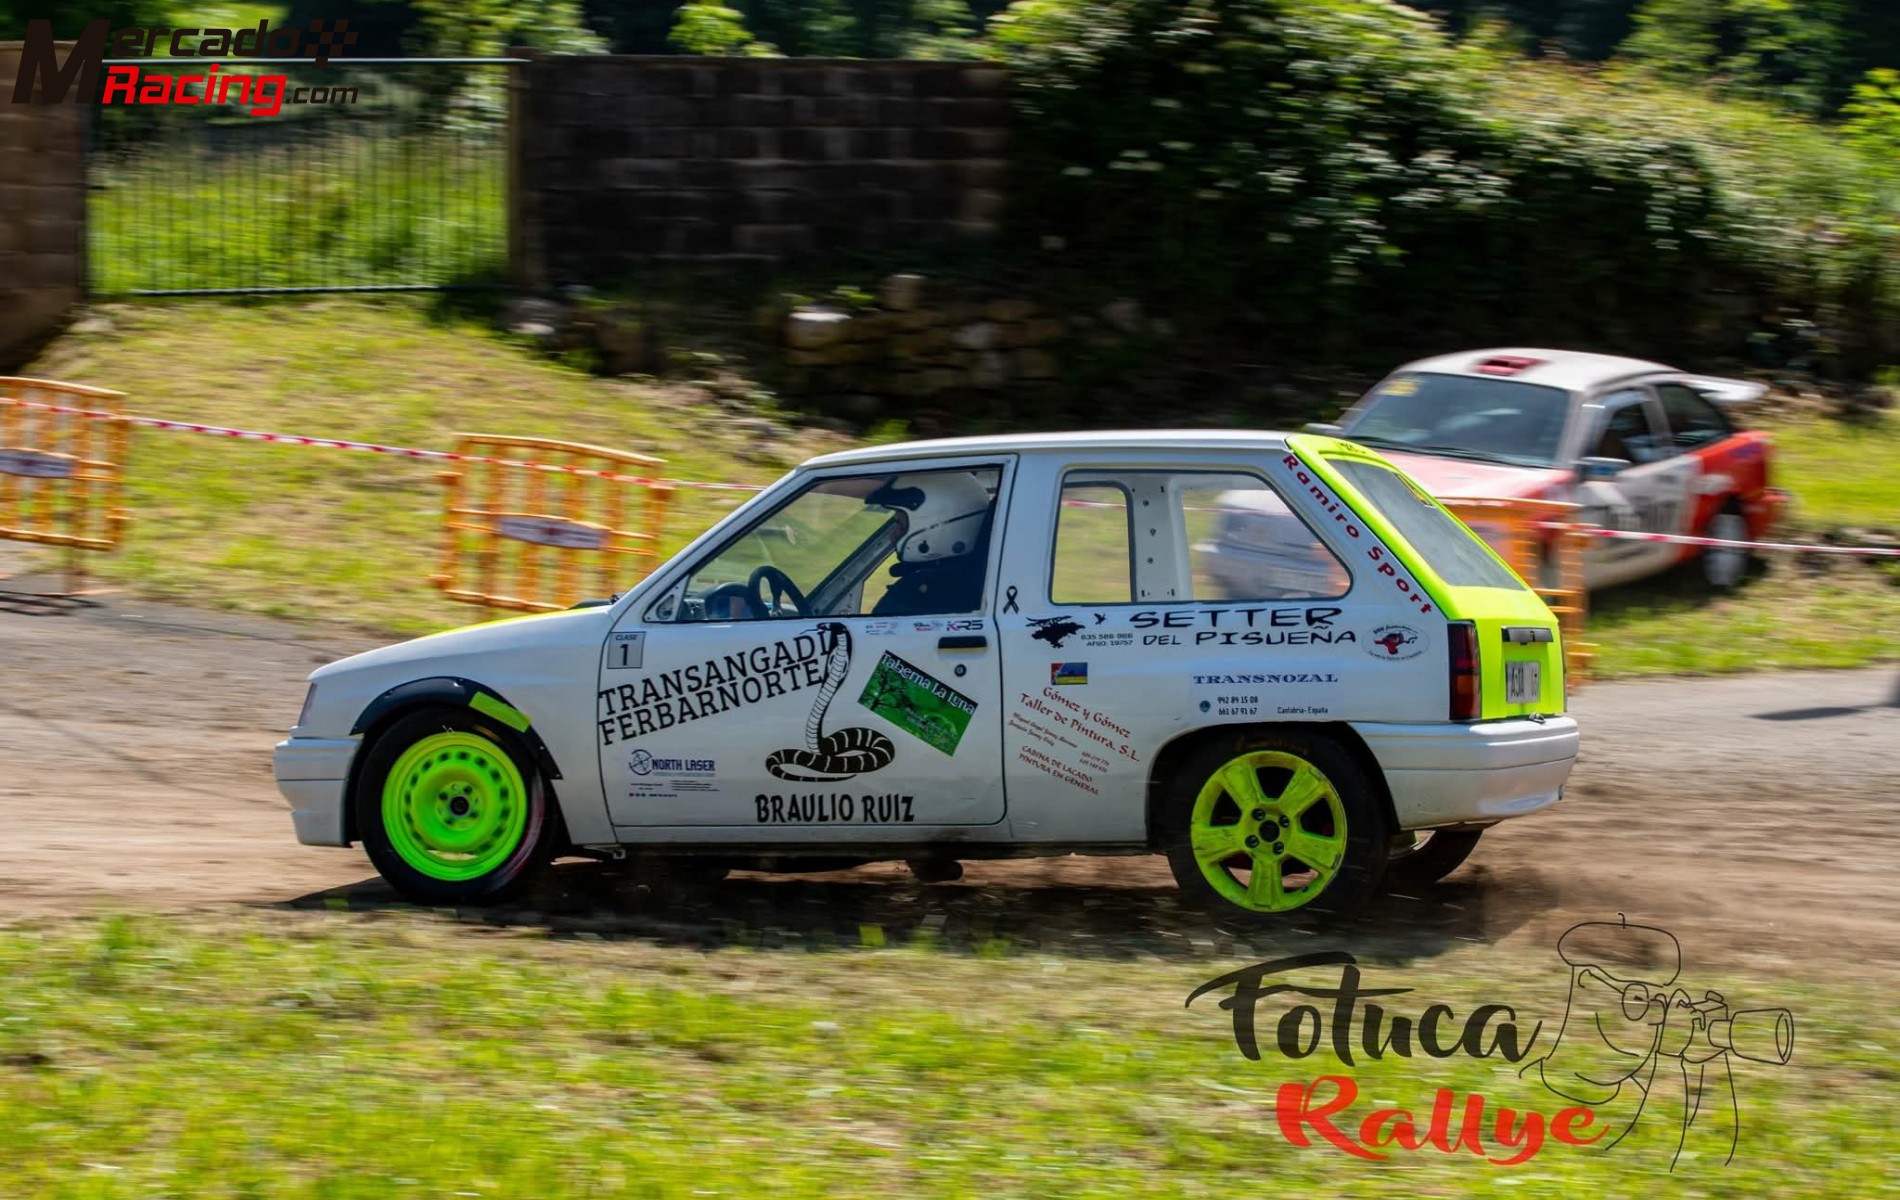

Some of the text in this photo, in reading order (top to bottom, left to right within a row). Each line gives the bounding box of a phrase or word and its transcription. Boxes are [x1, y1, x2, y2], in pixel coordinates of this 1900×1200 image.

[1283, 455, 1359, 538] Ramiro
[1367, 546, 1432, 614] Sport
[1129, 607, 1342, 628] SETTER
[1143, 634, 1181, 646] DEL
[1196, 625, 1356, 646] PISUEÑA
[620, 643, 629, 666] 1
[597, 631, 829, 716] TRANSANGADI
[881, 653, 932, 690] Taberna
[931, 682, 947, 699] La
[1193, 673, 1339, 685] TRANSNOZAL
[597, 658, 824, 746] FERBARNORTE
[1020, 692, 1053, 716] Taller
[1054, 711, 1068, 725] de
[1043, 686, 1081, 712] Gómez
[1083, 708, 1091, 721] y
[1093, 712, 1131, 739] Gómez
[651, 758, 716, 772] NORTH LASER
[1019, 753, 1099, 796] PINTURA EN GENERAL
[1022, 745, 1050, 764] CABINA
[1051, 758, 1063, 769] DE
[1063, 764, 1093, 783] LACADO
[754, 793, 915, 823] BRAULIO RUIZ
